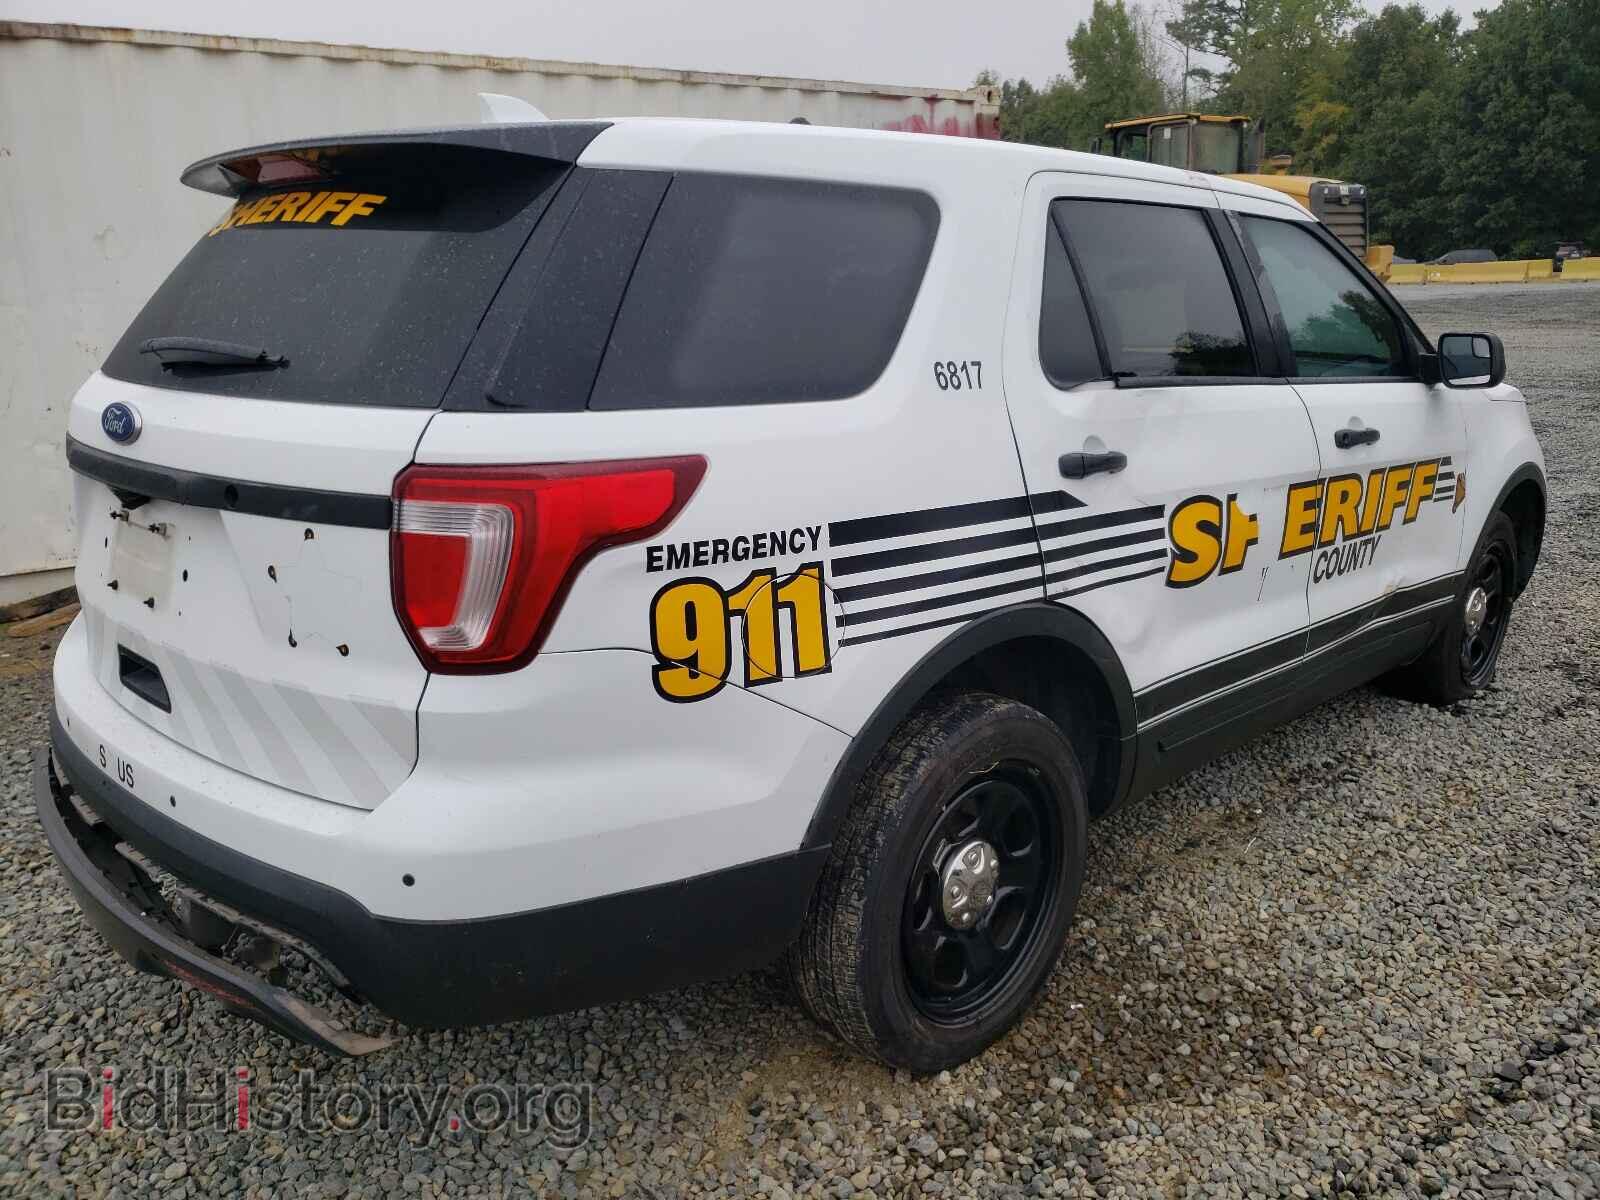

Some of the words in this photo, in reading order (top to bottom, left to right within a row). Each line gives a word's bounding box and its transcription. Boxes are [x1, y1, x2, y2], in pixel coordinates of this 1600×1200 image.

[933, 360, 982, 391] 6817
[104, 406, 128, 434] Ford
[646, 525, 822, 573] EMERGENCY
[1312, 535, 1382, 584] COUNTY
[650, 560, 832, 703] 911
